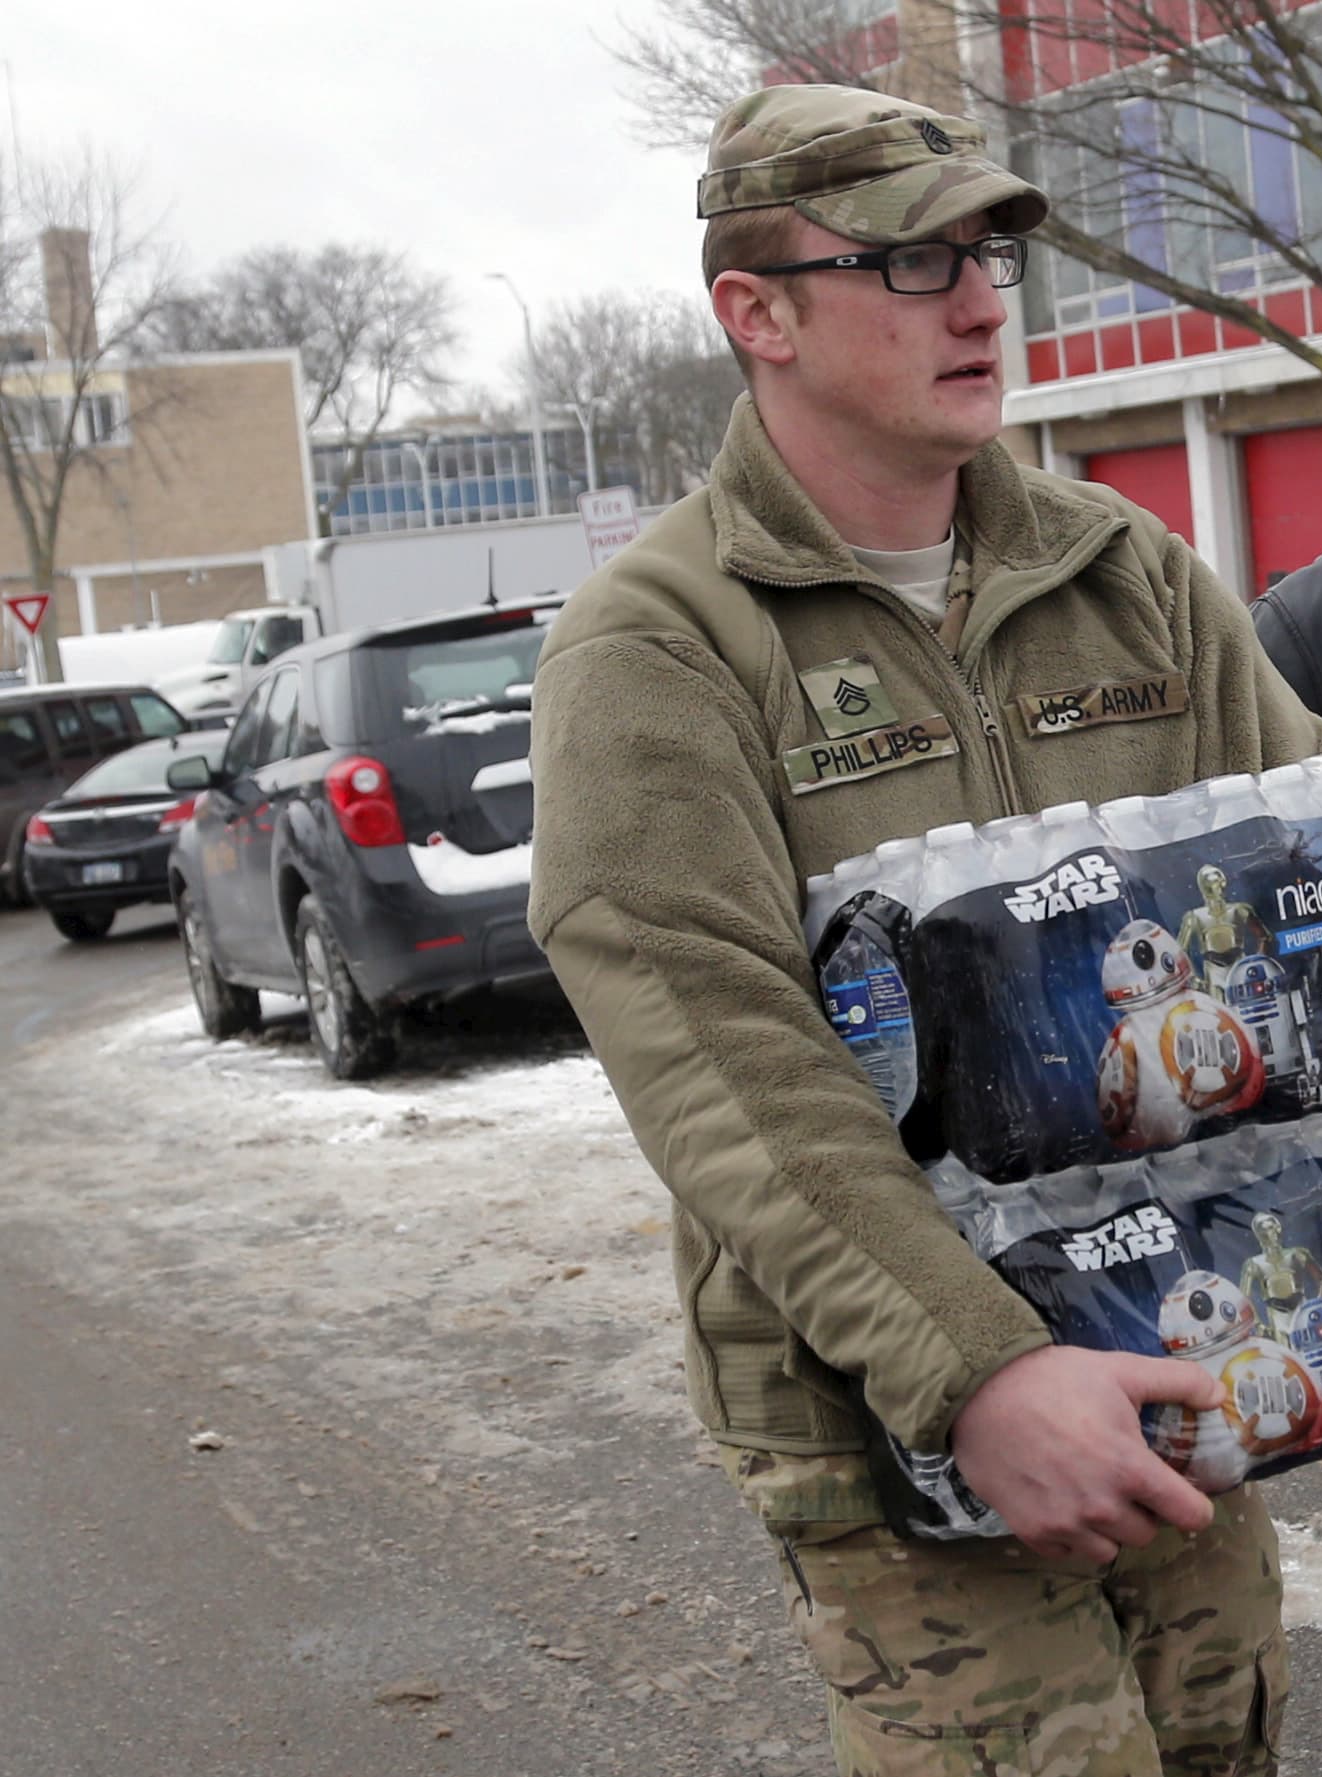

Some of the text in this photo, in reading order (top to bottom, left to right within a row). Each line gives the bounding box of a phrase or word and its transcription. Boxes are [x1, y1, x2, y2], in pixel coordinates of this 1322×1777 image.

[1039, 679, 1168, 726] U.S. ARMY
[810, 724, 933, 780] PHILLIPS
[1003, 853, 1118, 905] STAR
[1005, 874, 1122, 923] WARS
[1061, 1206, 1175, 1252] STAR
[1064, 1226, 1178, 1271] WARS
